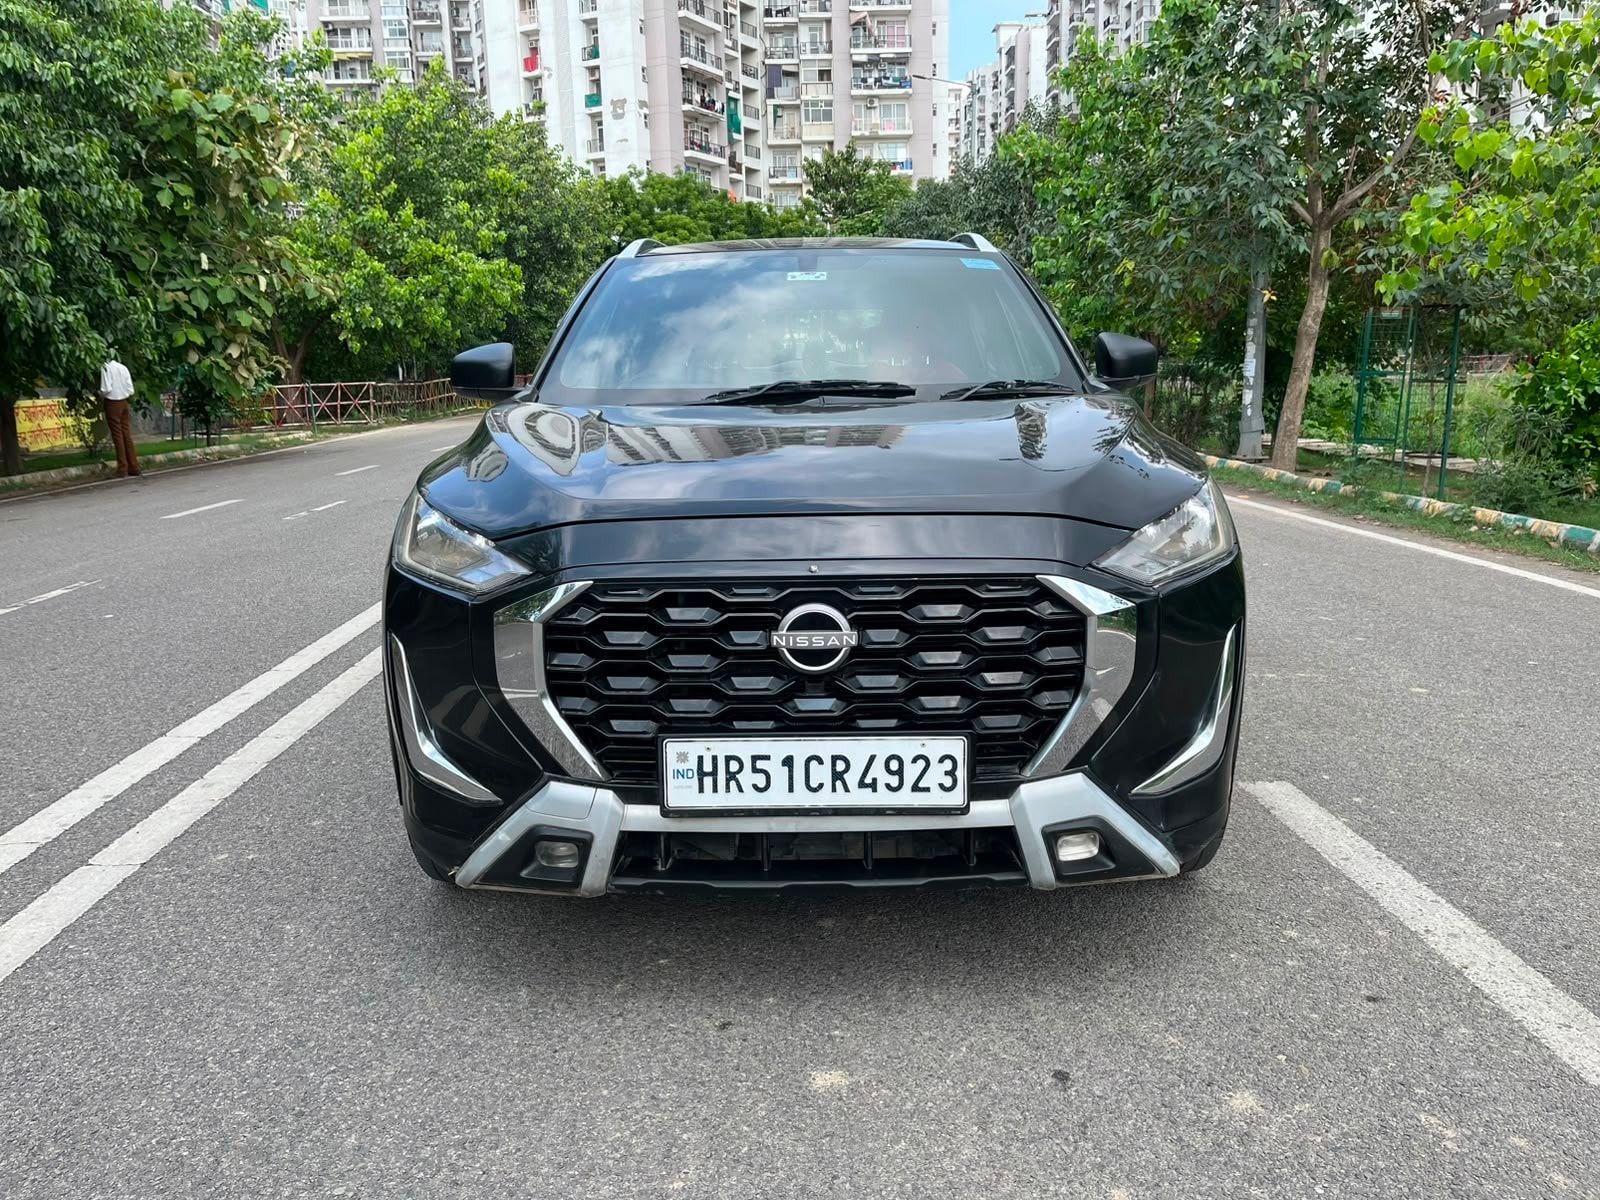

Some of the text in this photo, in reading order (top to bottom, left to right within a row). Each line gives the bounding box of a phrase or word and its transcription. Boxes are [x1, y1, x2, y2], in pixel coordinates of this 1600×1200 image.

[773, 634, 856, 647] NISSAN
[672, 768, 695, 780] IND
[697, 754, 958, 794] HR51CR4923
